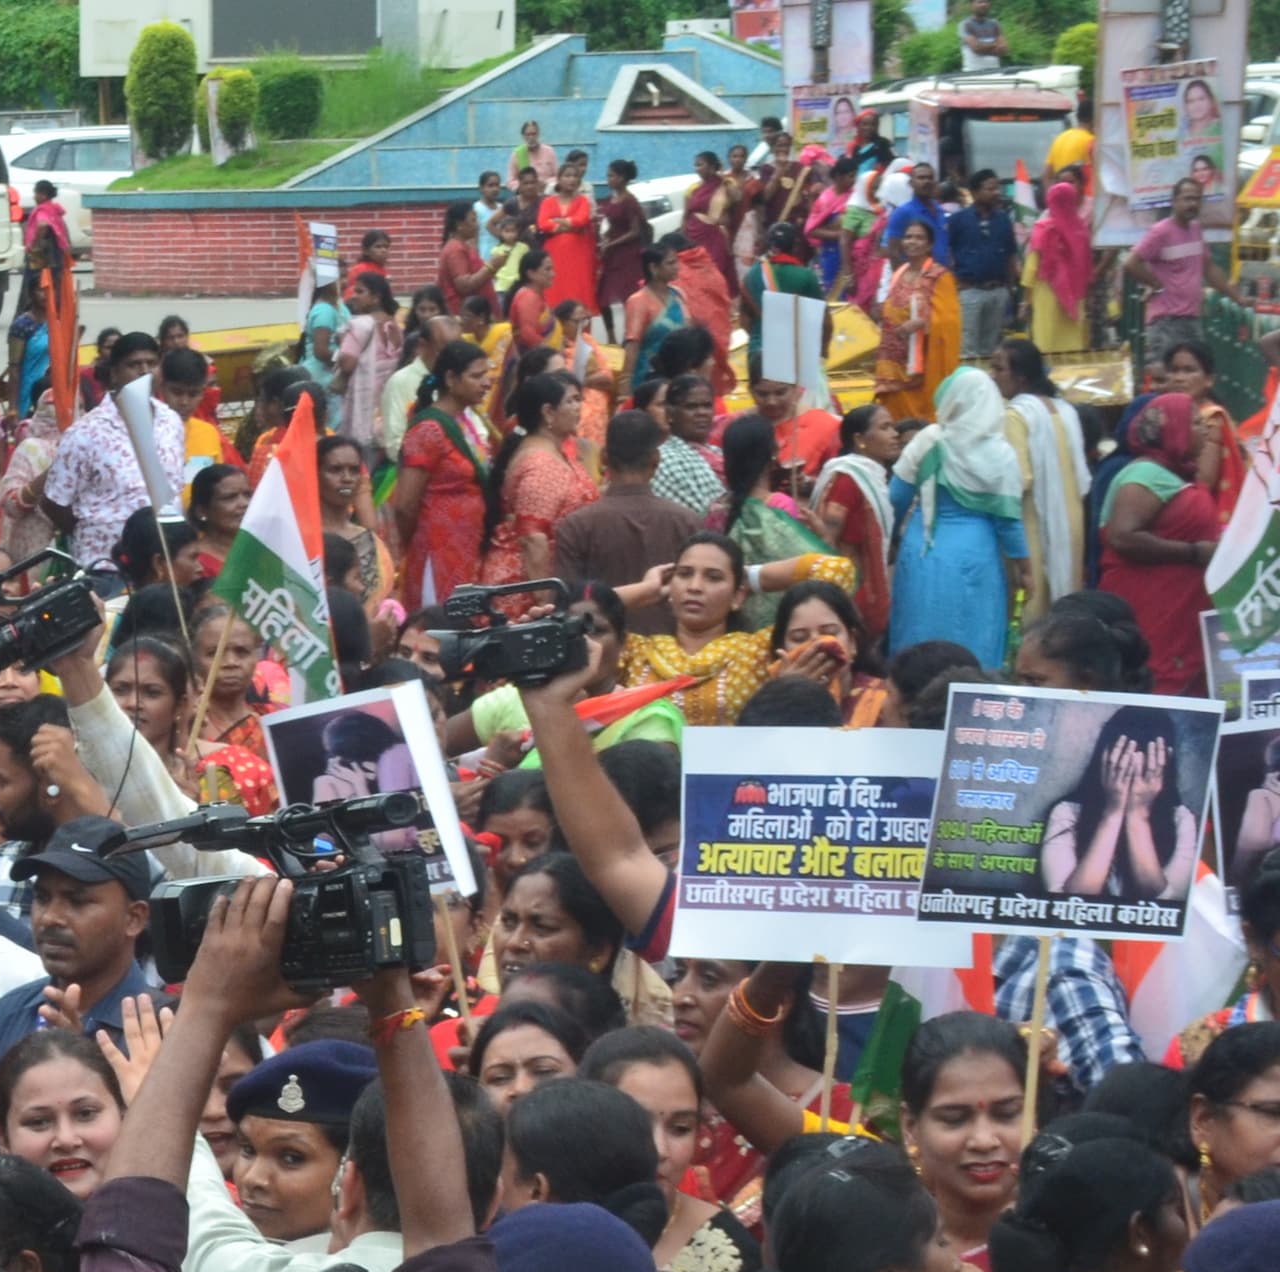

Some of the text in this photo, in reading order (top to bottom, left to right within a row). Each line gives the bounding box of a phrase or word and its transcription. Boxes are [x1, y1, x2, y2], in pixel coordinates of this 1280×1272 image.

[241, 577, 329, 671] महिला
[986, 758, 1039, 785] अधिक
[767, 783, 826, 808] भाजपा
[828, 777, 846, 808] ने
[728, 807, 814, 840] महिलाओं
[825, 809, 854, 841] को
[856, 810, 879, 842] दो
[971, 819, 1044, 845] महिलाओं
[696, 842, 796, 875] अत्याचार
[798, 834, 849, 878] और
[980, 855, 1038, 875] अपराध
[780, 882, 831, 908] प्रदेश
[834, 884, 903, 912] महिला
[998, 892, 1050, 920] प्रदेश
[1052, 895, 1114, 925] महिला
[1117, 898, 1180, 928] कांग्रेस
